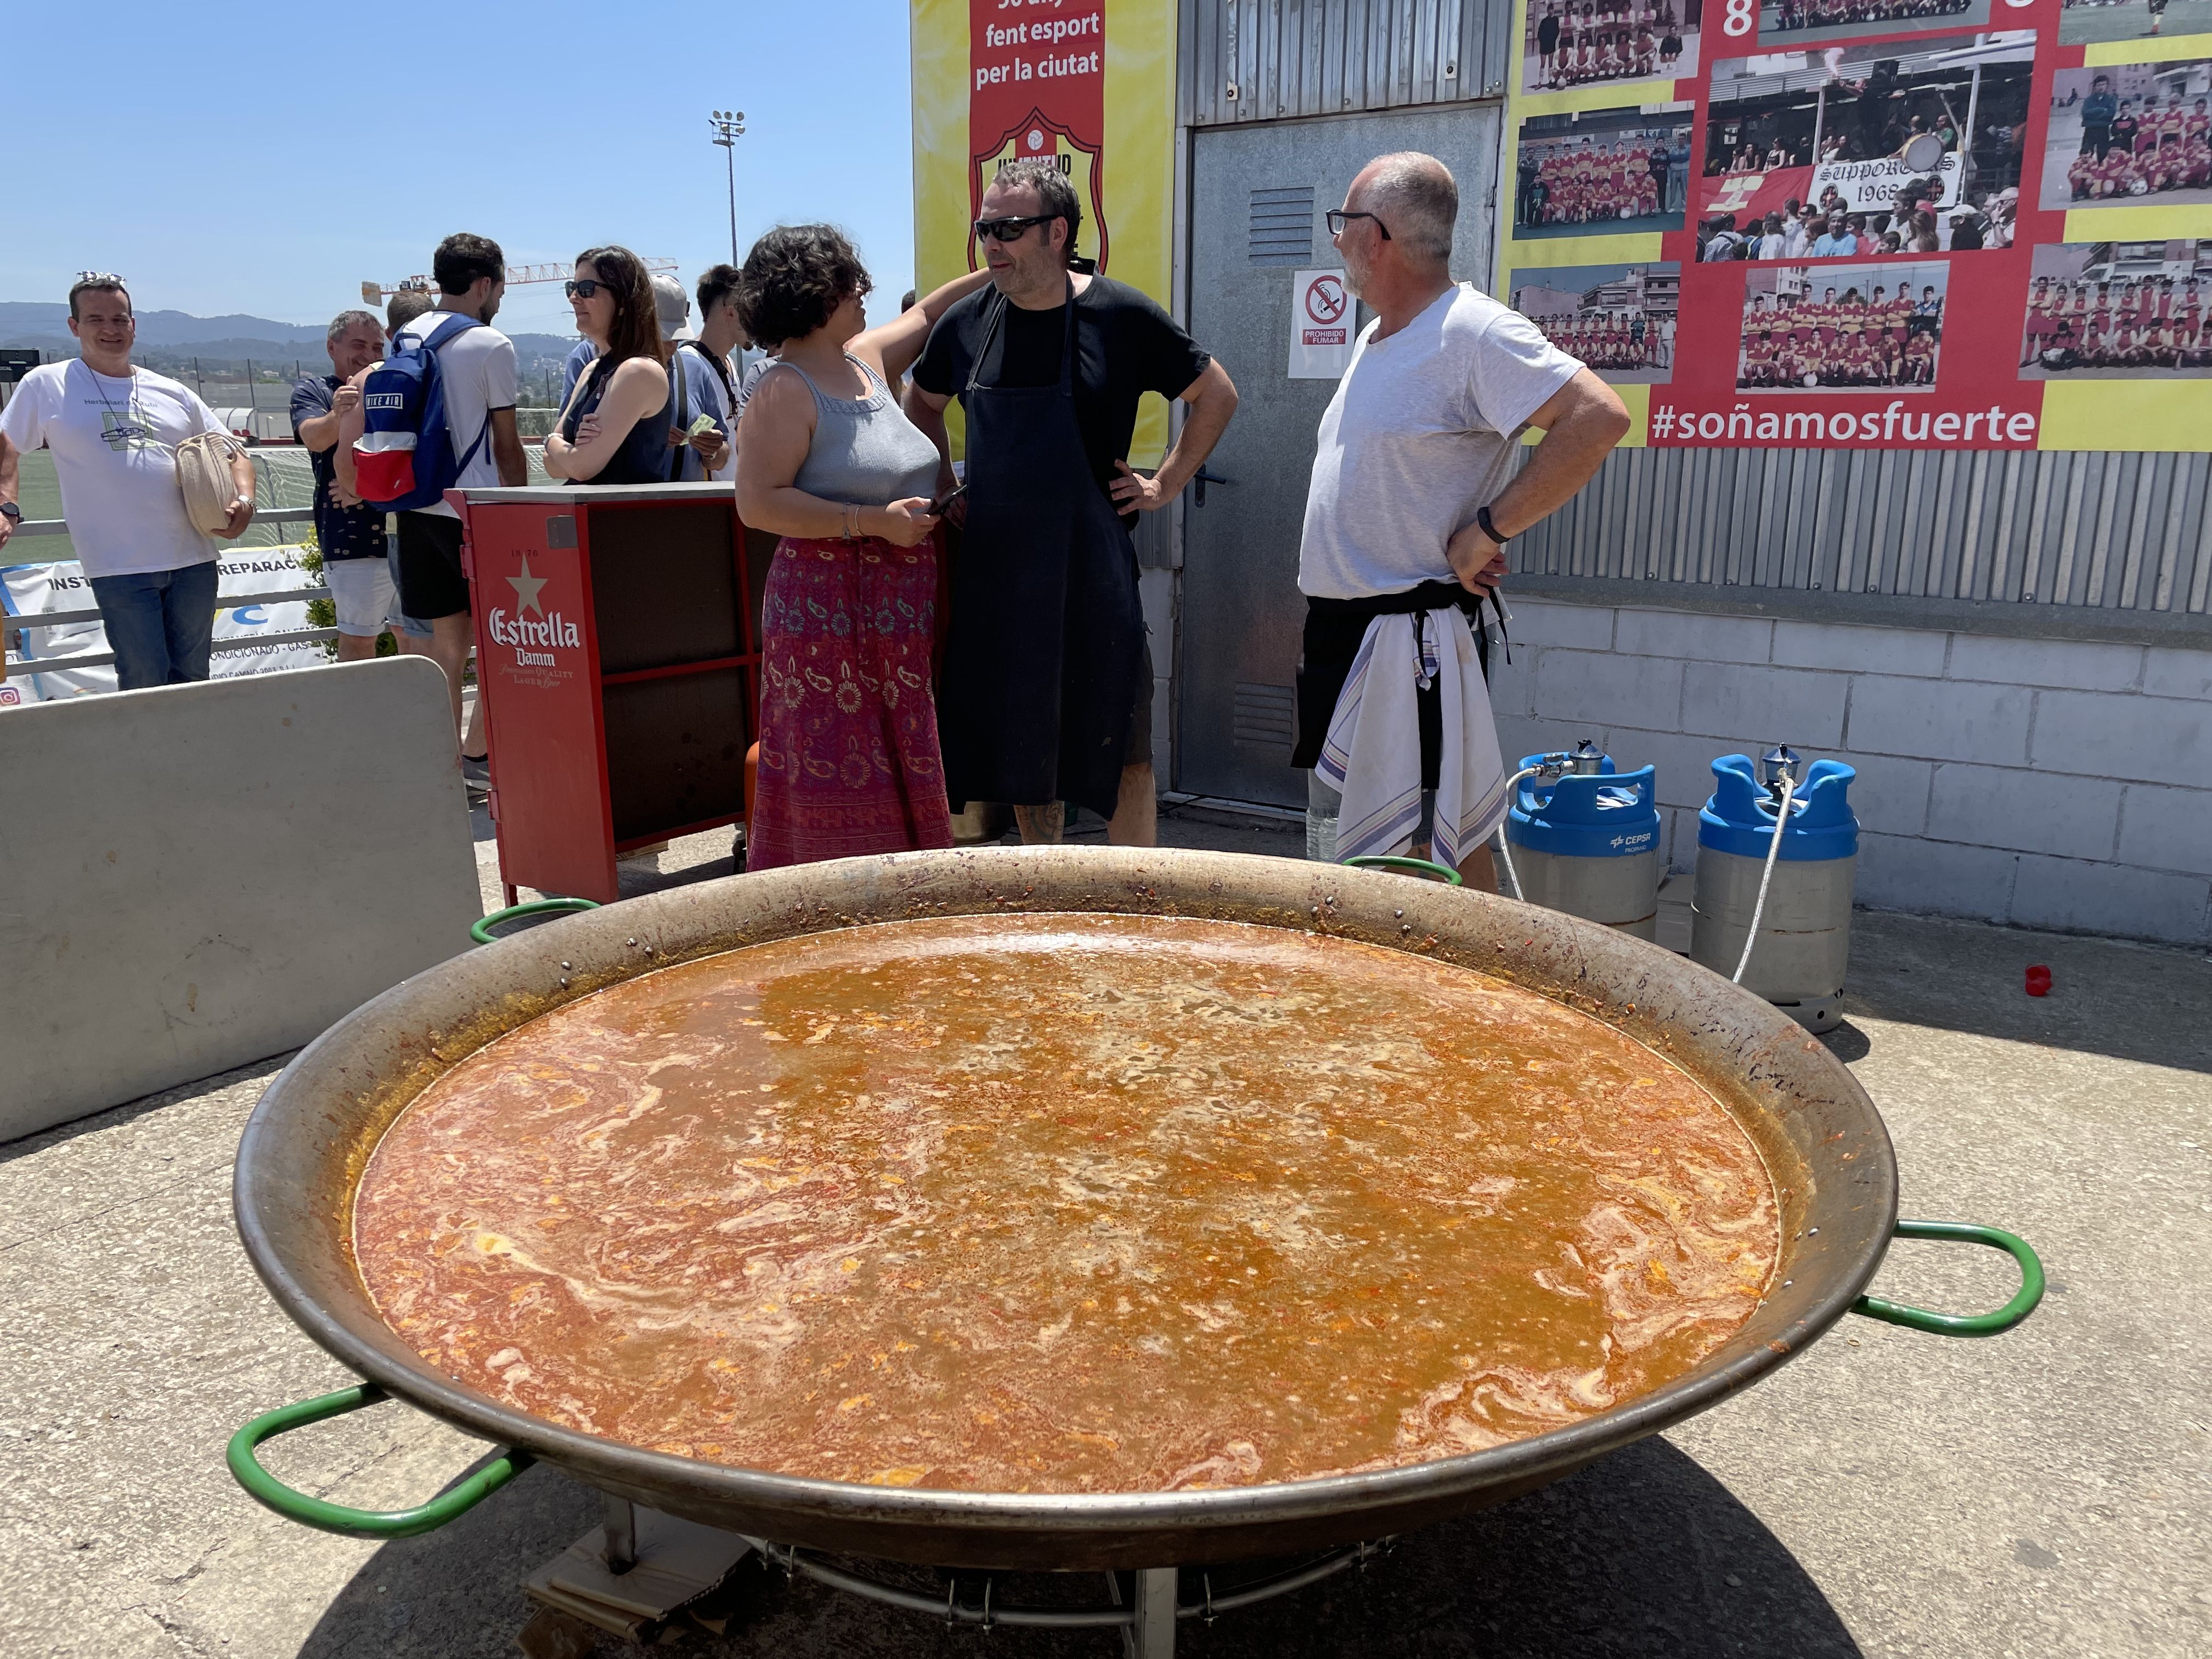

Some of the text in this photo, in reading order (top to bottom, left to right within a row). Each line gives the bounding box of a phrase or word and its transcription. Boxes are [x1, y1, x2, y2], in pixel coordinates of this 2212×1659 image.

[986, 12, 1099, 47] fent esport
[976, 51, 1098, 91] per la ciutat
[1652, 400, 2035, 441] #soñamosfuerte
[489, 607, 580, 648] Estrella
[514, 647, 556, 667] Damm
[1625, 832, 1651, 845] CEPSA
